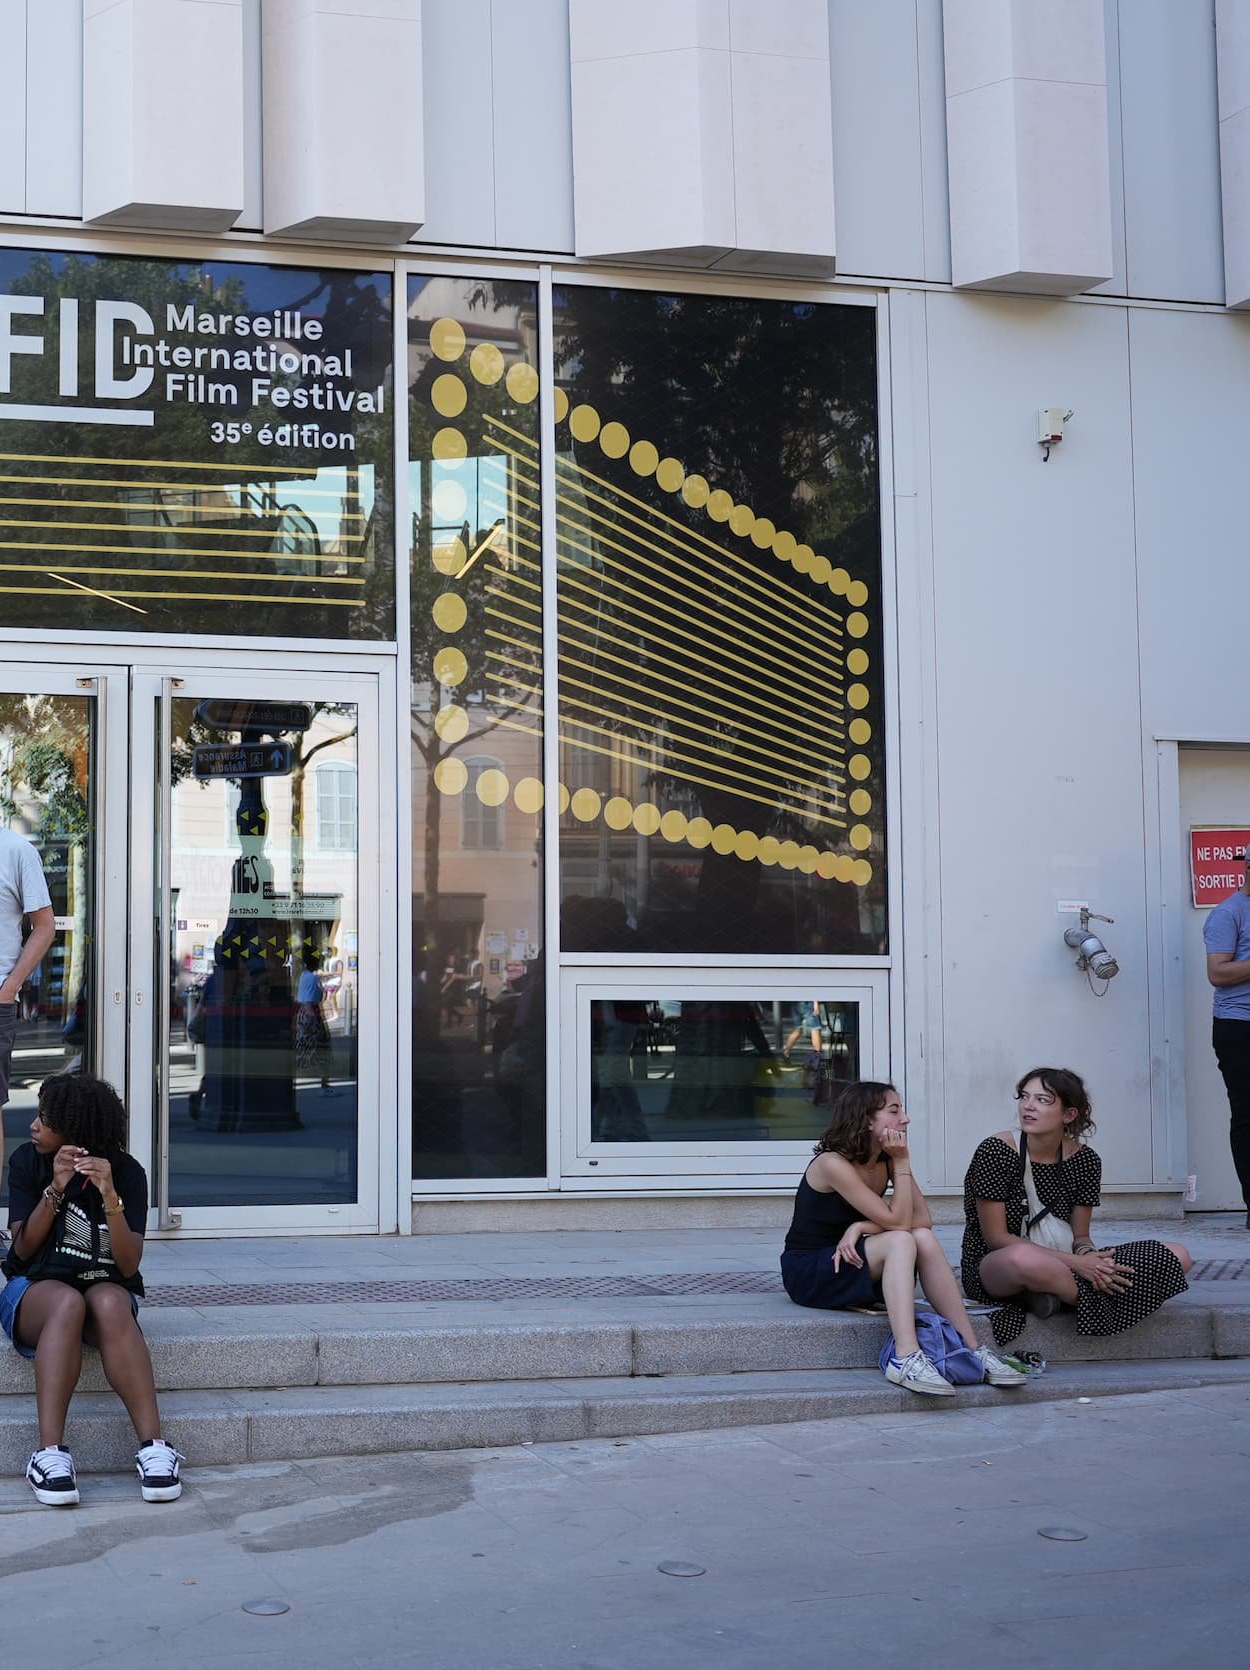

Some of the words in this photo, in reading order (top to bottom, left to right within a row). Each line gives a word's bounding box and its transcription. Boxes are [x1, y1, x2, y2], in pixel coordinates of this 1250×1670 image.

[166, 304, 323, 341] Marseille
[122, 336, 352, 377] International
[166, 373, 238, 405] Film
[252, 381, 384, 414] Festival
[257, 423, 356, 450] édition
[1197, 847, 1210, 860] NE
[1213, 847, 1233, 860] PAS
[1199, 874, 1236, 888] SORTIE
